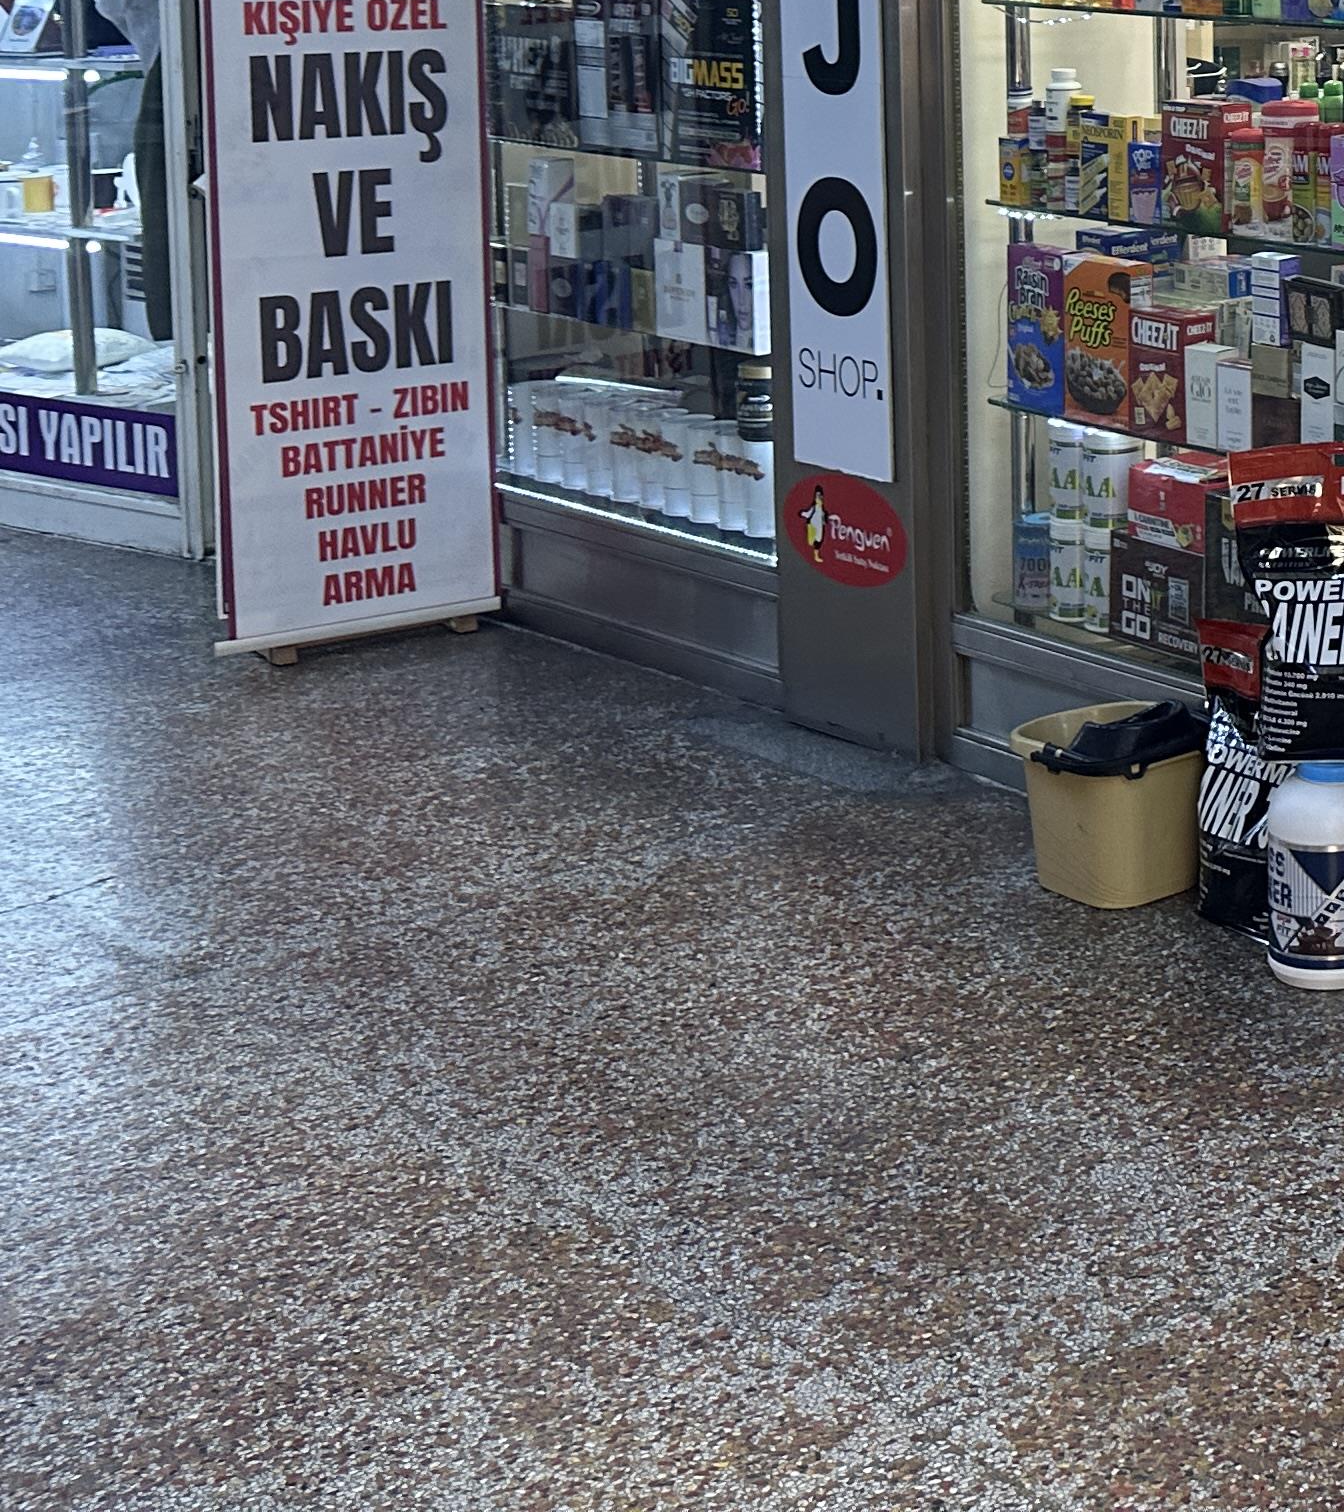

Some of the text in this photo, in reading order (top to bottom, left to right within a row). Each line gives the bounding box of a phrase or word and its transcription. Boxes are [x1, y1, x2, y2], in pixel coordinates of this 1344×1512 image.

[249, 48, 448, 163] NAKIŞ
[312, 168, 395, 257] VE
[1018, 288, 1045, 309] Bran
[1066, 287, 1117, 320] Reese's
[258, 280, 453, 383] BASKI
[1070, 319, 1112, 347] Puffs
[249, 393, 359, 436] TSHIRT
[392, 380, 470, 419] ZIBIN
[39, 409, 169, 478] YAPILIR
[281, 425, 445, 478] BATTANİYE
[305, 474, 426, 519] RUNNER
[1237, 483, 1264, 502] 27
[318, 518, 417, 562] HAVLU
[323, 562, 418, 606] ARMA
[1121, 574, 1151, 602] ON
[1121, 615, 1151, 640] GO
[1122, 597, 1151, 618] THE
